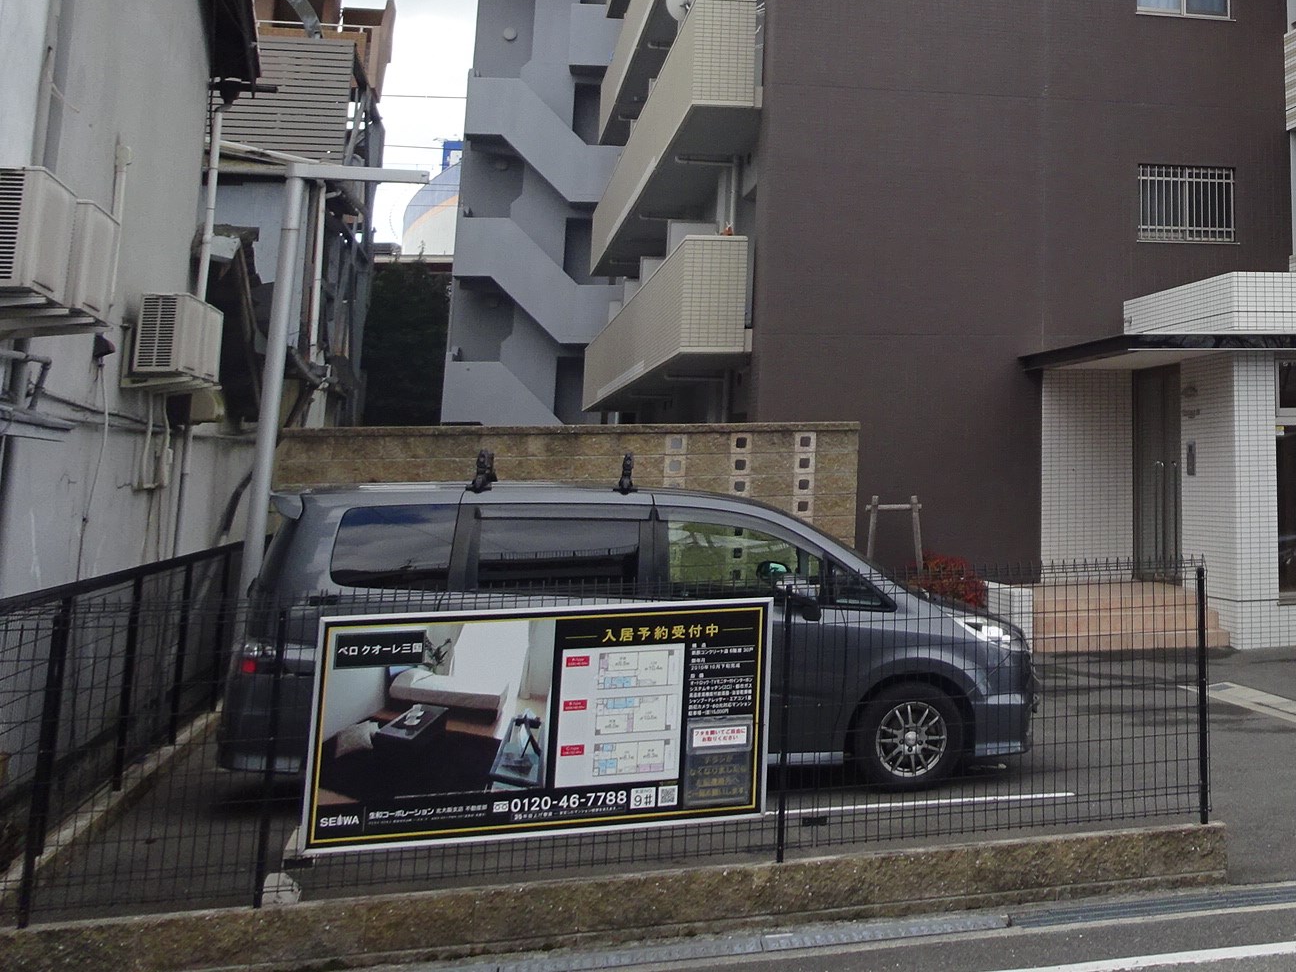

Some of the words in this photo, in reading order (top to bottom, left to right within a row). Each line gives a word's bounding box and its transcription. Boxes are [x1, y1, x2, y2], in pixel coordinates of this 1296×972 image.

[602, 623, 719, 642] 入居予約受付中
[361, 642, 423, 656] クオーレ三国
[510, 790, 627, 813] 0120-46-7788
[320, 814, 360, 827] SEIWA
